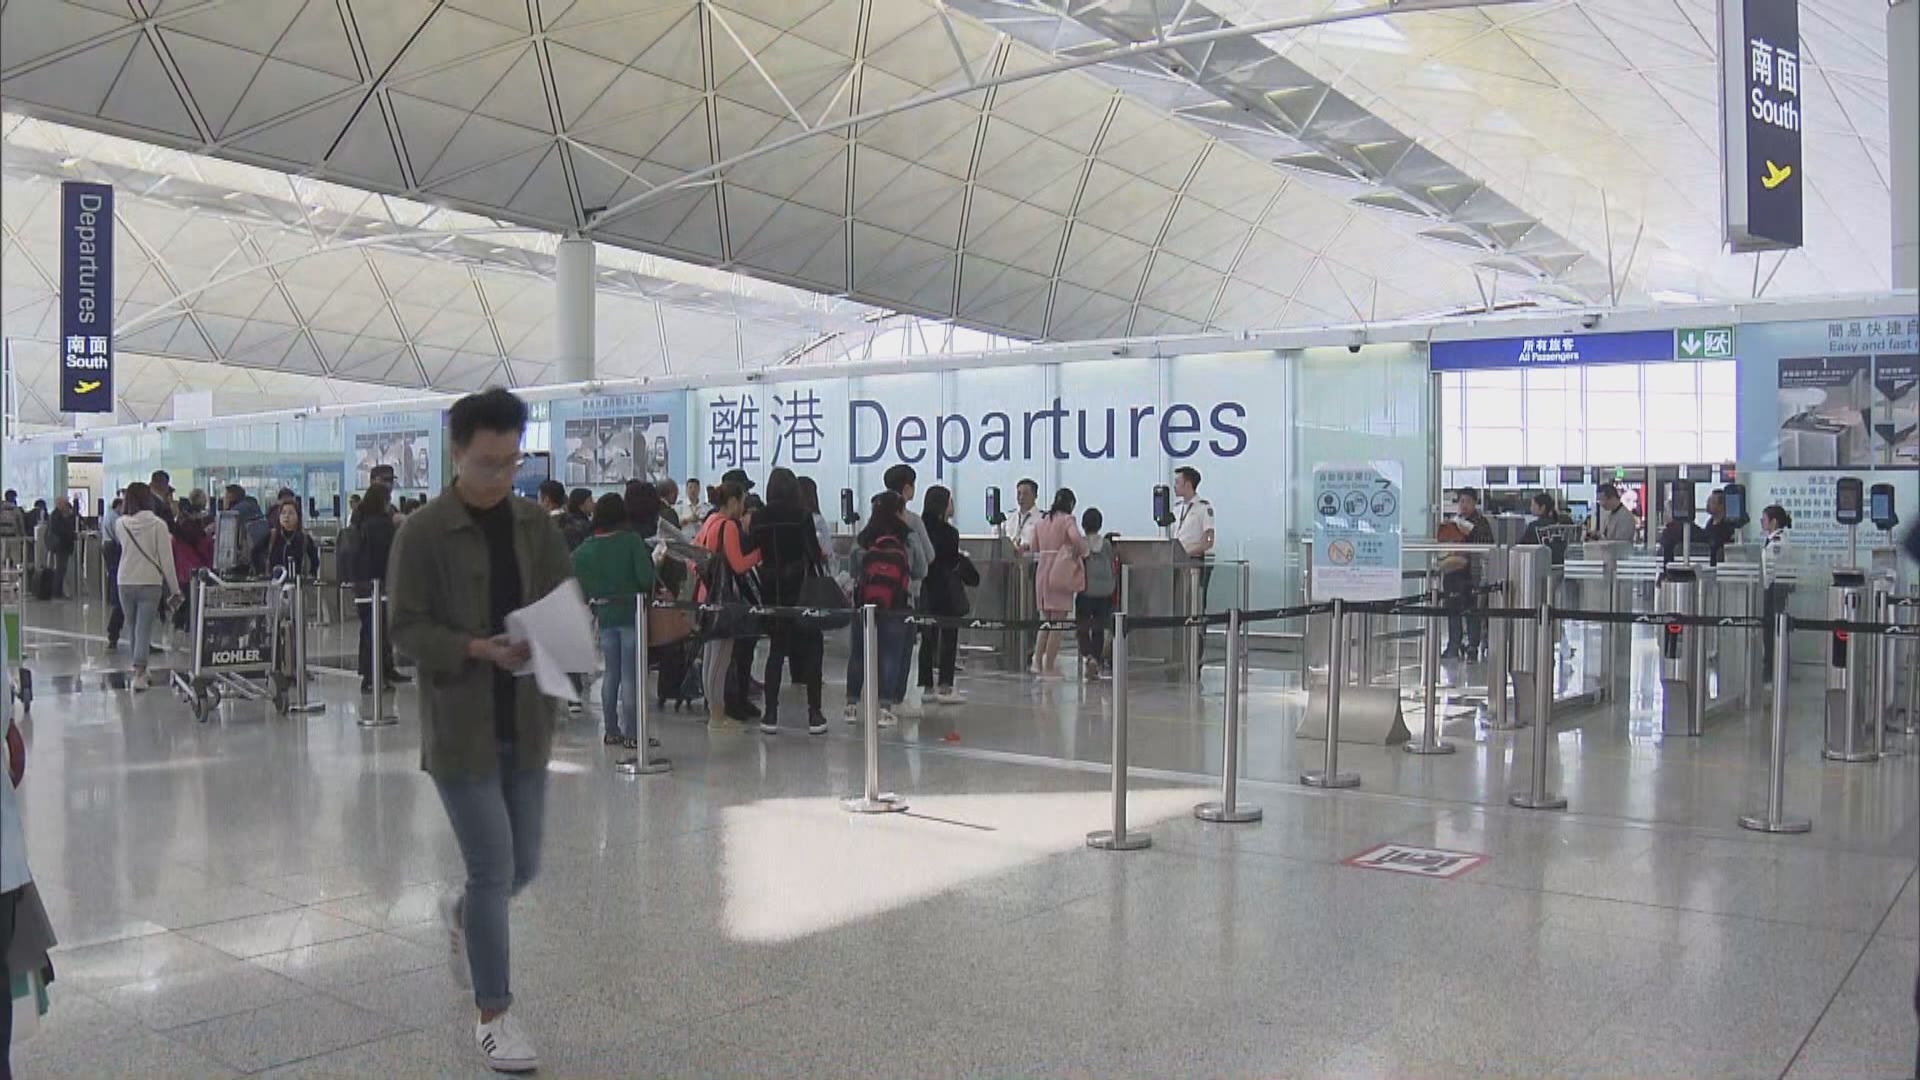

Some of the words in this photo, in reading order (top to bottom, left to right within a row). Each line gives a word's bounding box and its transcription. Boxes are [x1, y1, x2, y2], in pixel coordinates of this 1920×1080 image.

[1751, 38, 1797, 97] 南面
[1752, 88, 1799, 132] South
[74, 193, 102, 324] Departures
[66, 334, 108, 355] 南面
[1522, 337, 1575, 352] 所有旅客
[1829, 340, 1858, 353] Easy
[1862, 339, 1885, 351] and
[1889, 338, 1911, 350] fast
[66, 355, 108, 370] South
[1519, 351, 1531, 363] All
[1532, 351, 1579, 363] Passengers
[708, 388, 825, 470] 離港
[849, 396, 1248, 480] Departures
[211, 649, 261, 665] KOHLER
